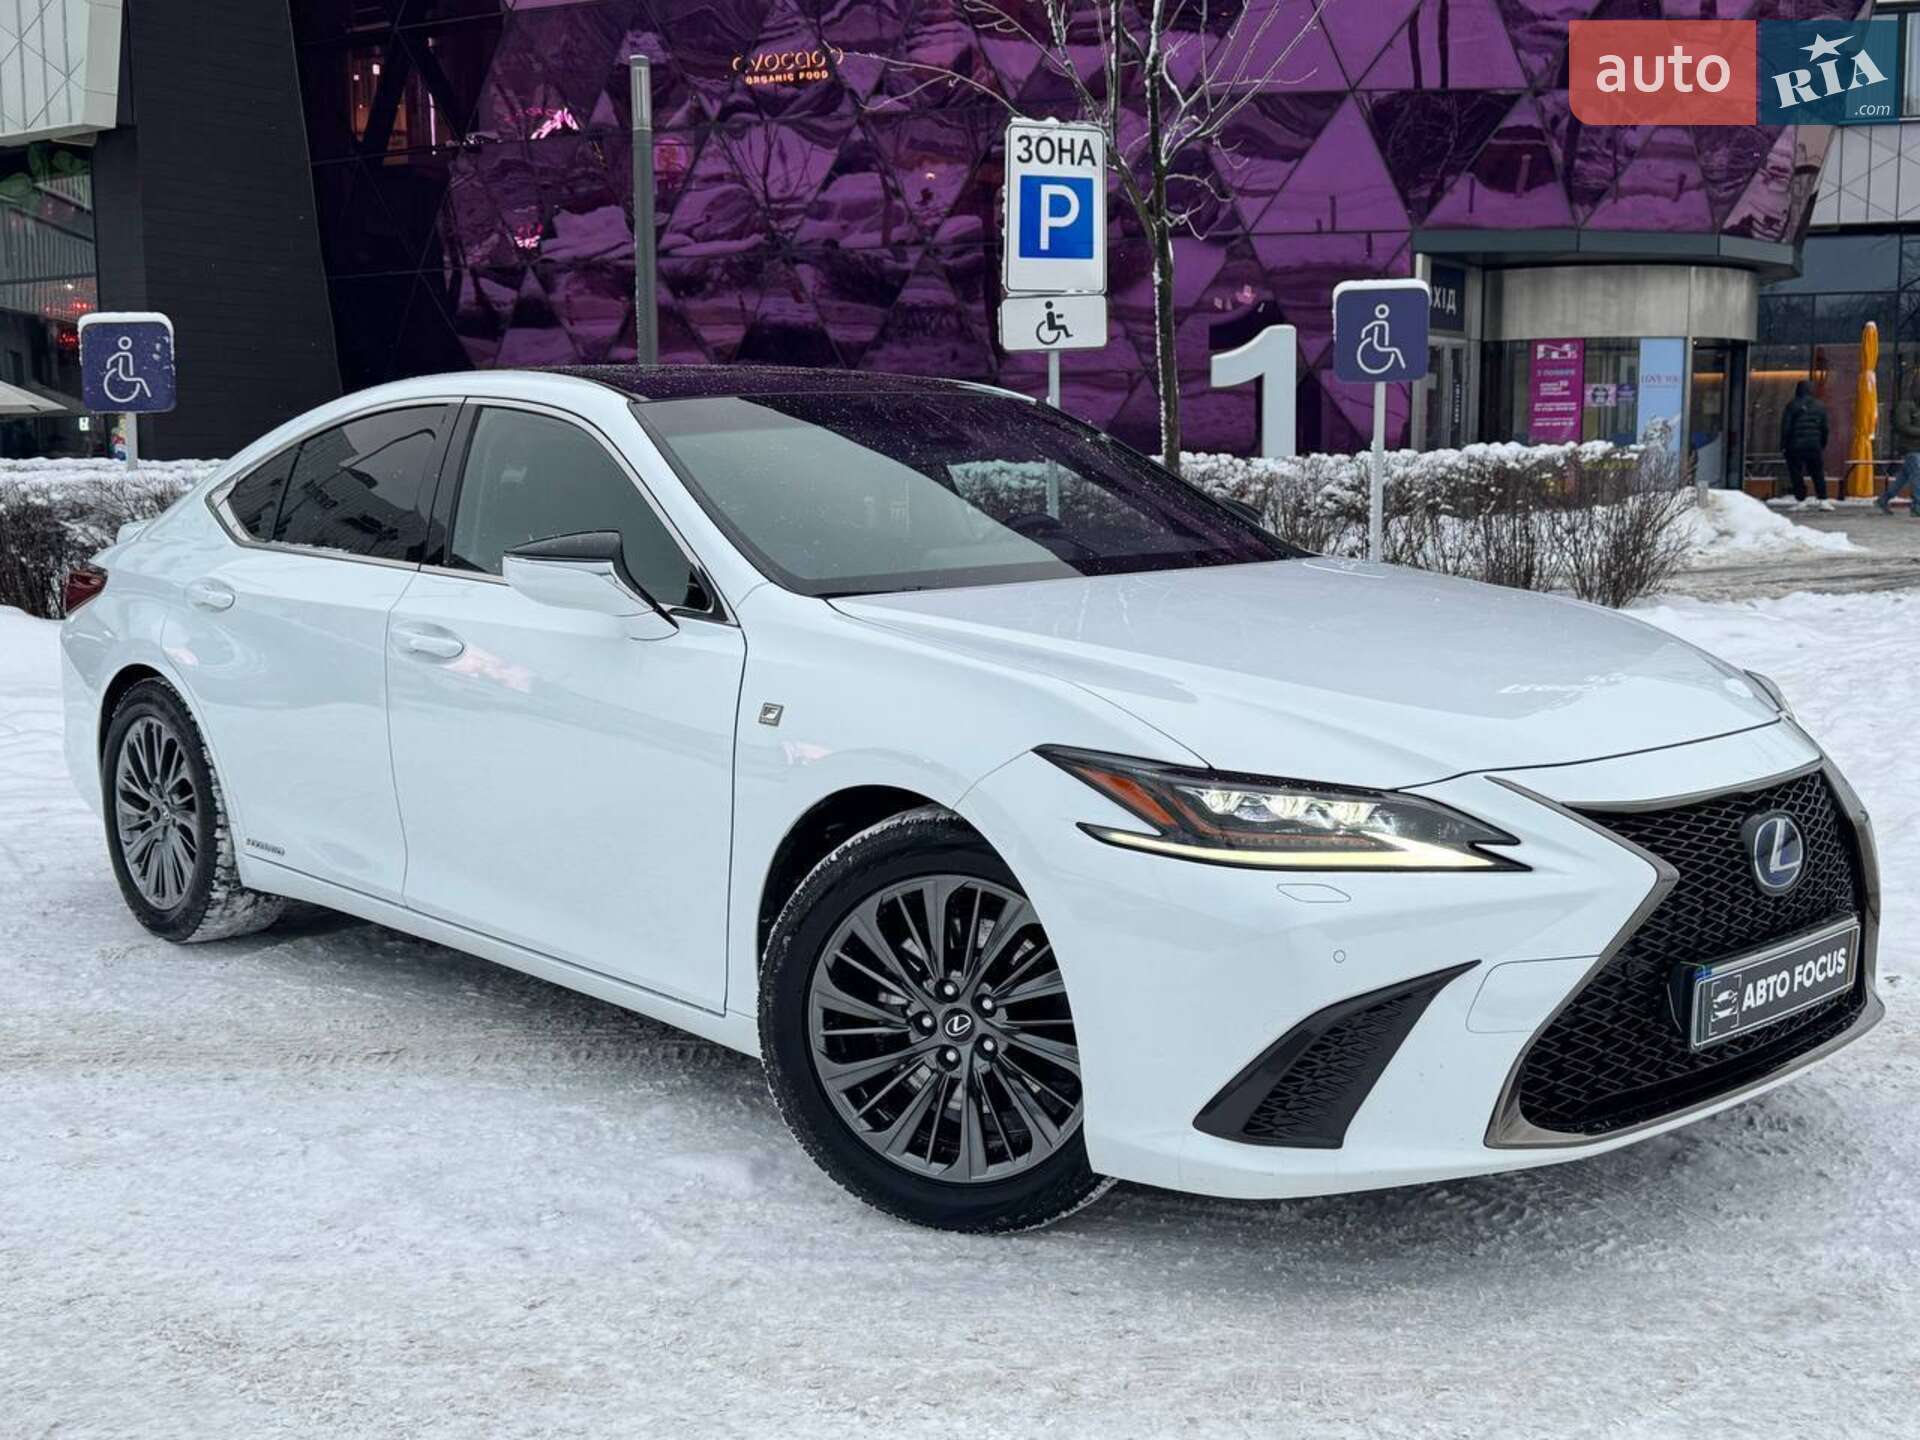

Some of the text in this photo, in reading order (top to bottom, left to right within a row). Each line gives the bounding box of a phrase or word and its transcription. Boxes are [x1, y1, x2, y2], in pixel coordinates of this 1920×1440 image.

[745, 70, 829, 85] ORGANIC FOOD
[1017, 135, 1097, 167] ЗОНА
[1040, 184, 1080, 250] P
[1432, 286, 1457, 315] ХІД
[1210, 324, 1297, 459] 1
[1794, 947, 1847, 992] FOCUS
